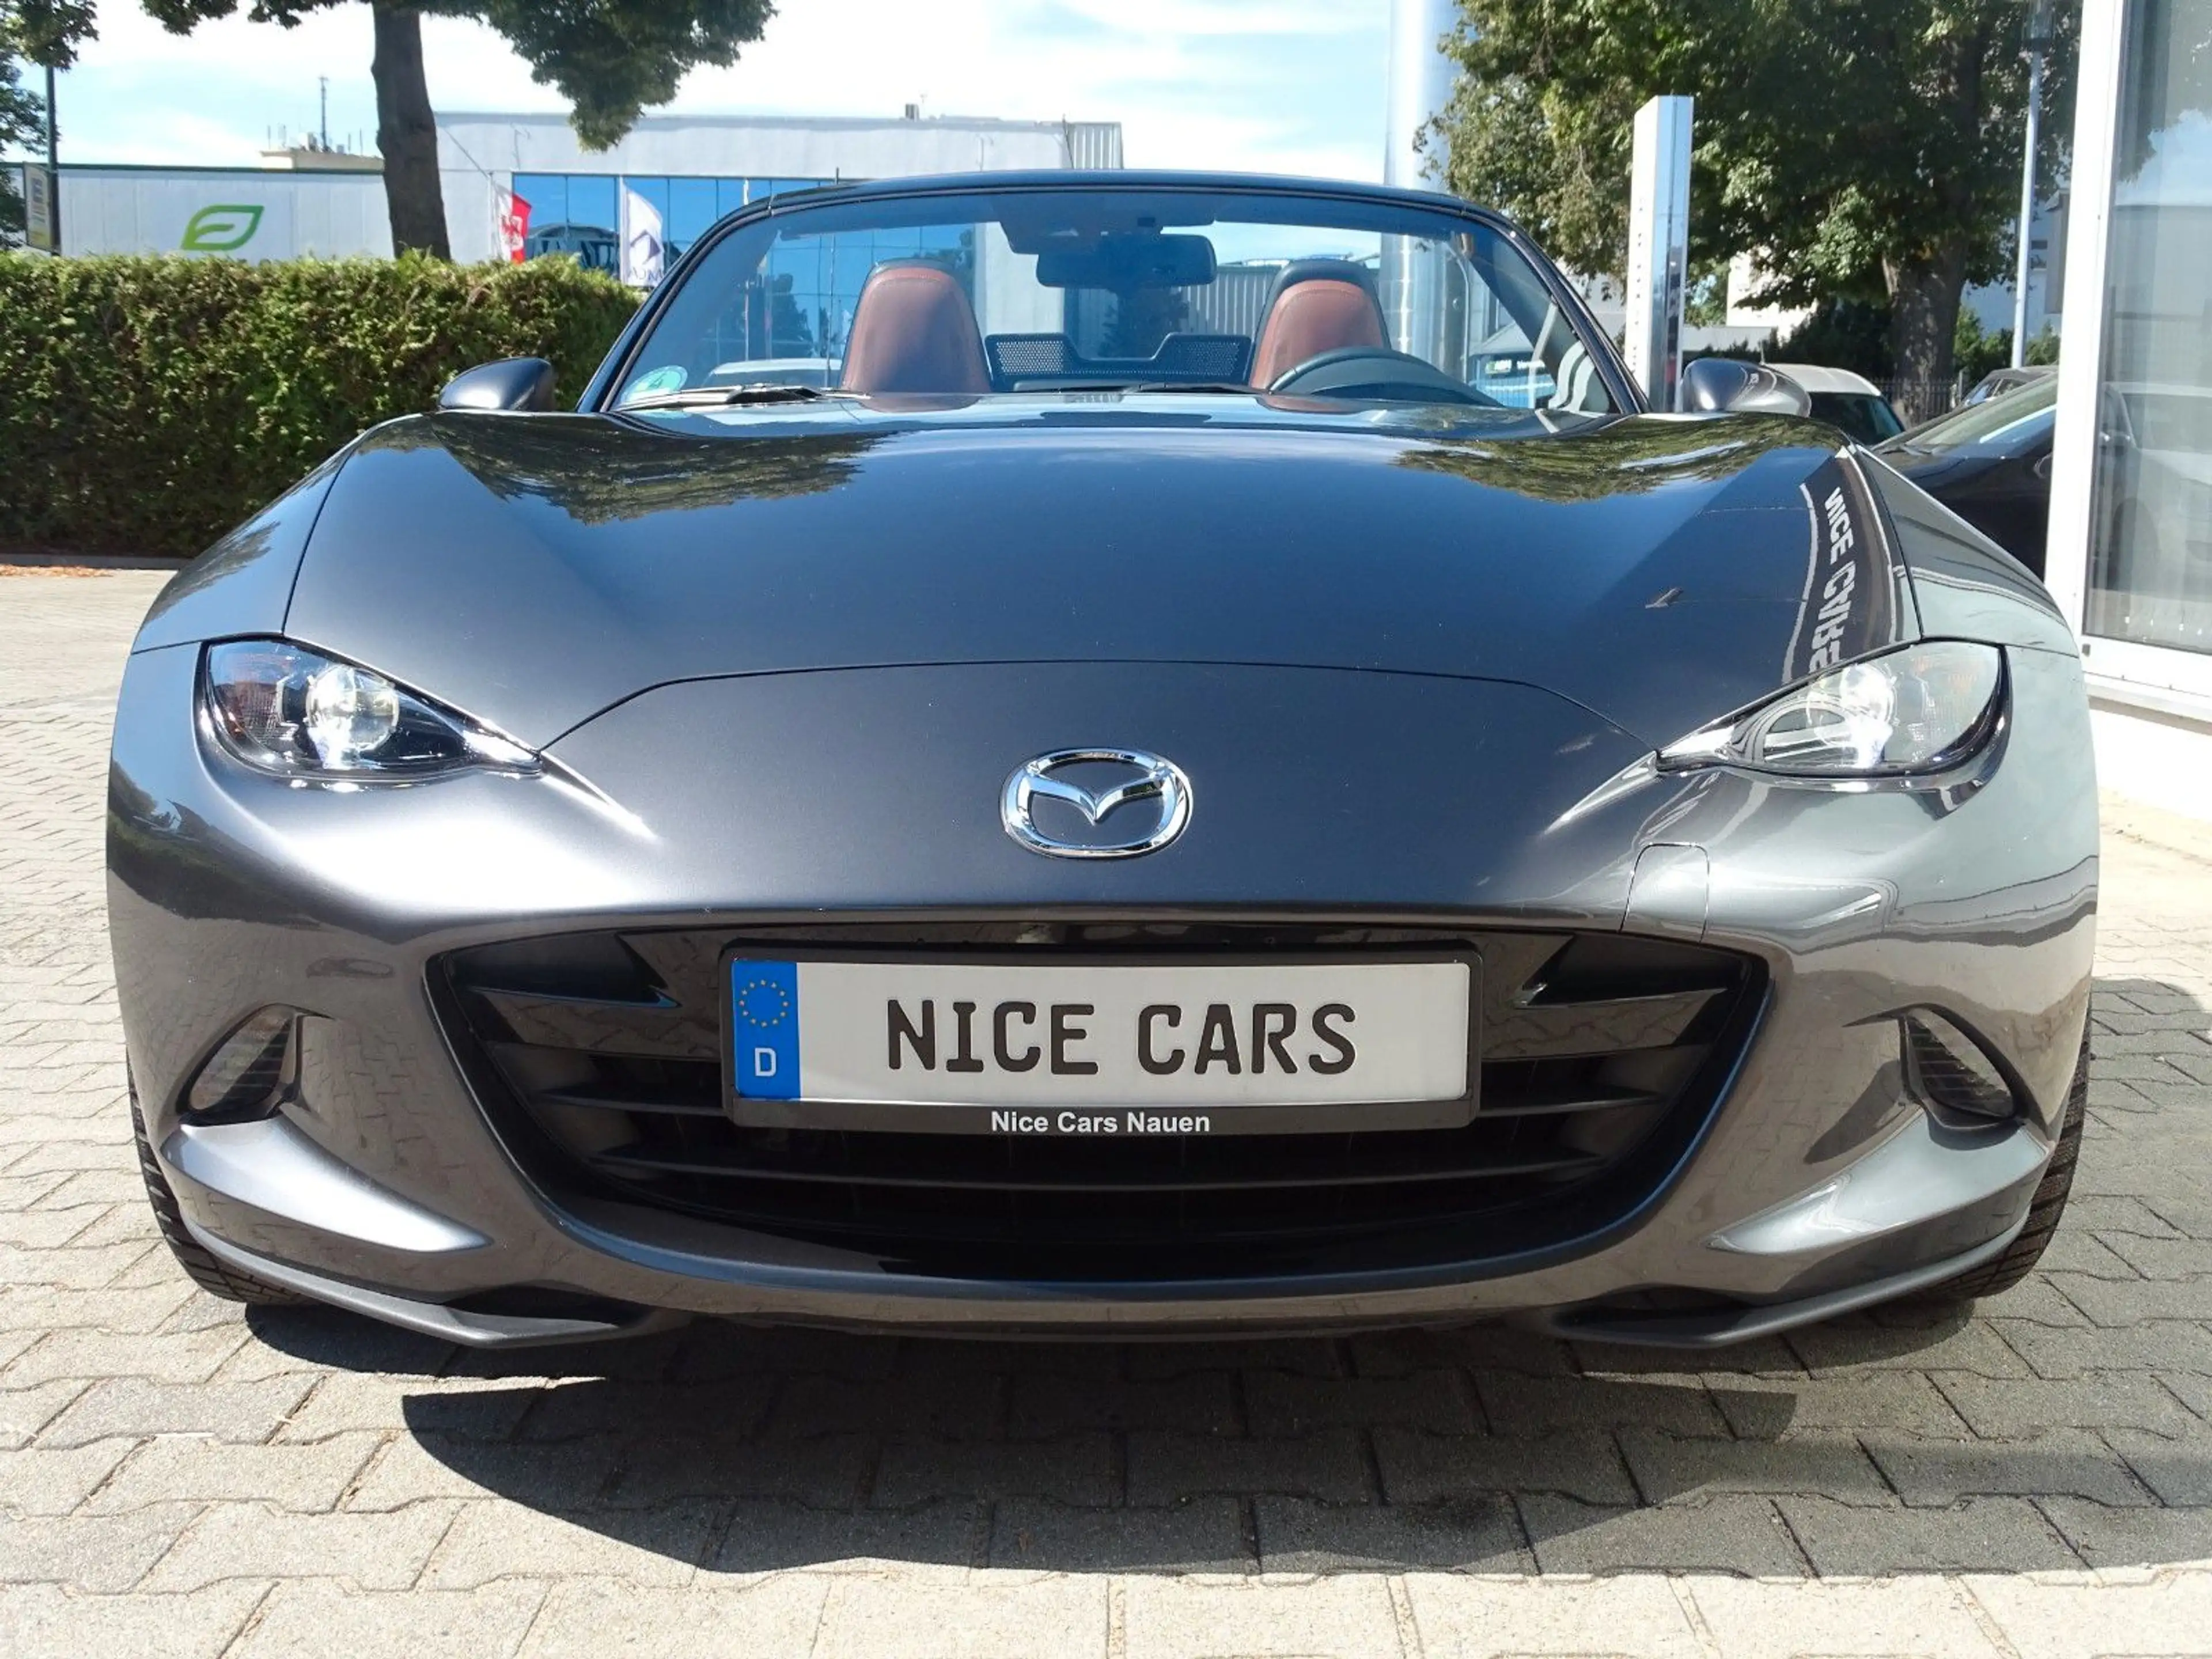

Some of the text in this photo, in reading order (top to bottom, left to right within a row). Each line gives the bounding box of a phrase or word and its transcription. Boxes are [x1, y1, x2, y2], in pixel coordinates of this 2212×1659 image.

[888, 999, 1356, 1074] NICE CARS
[755, 1048, 777, 1076] D
[991, 1111, 1209, 1132] Nice Cars Nauen
